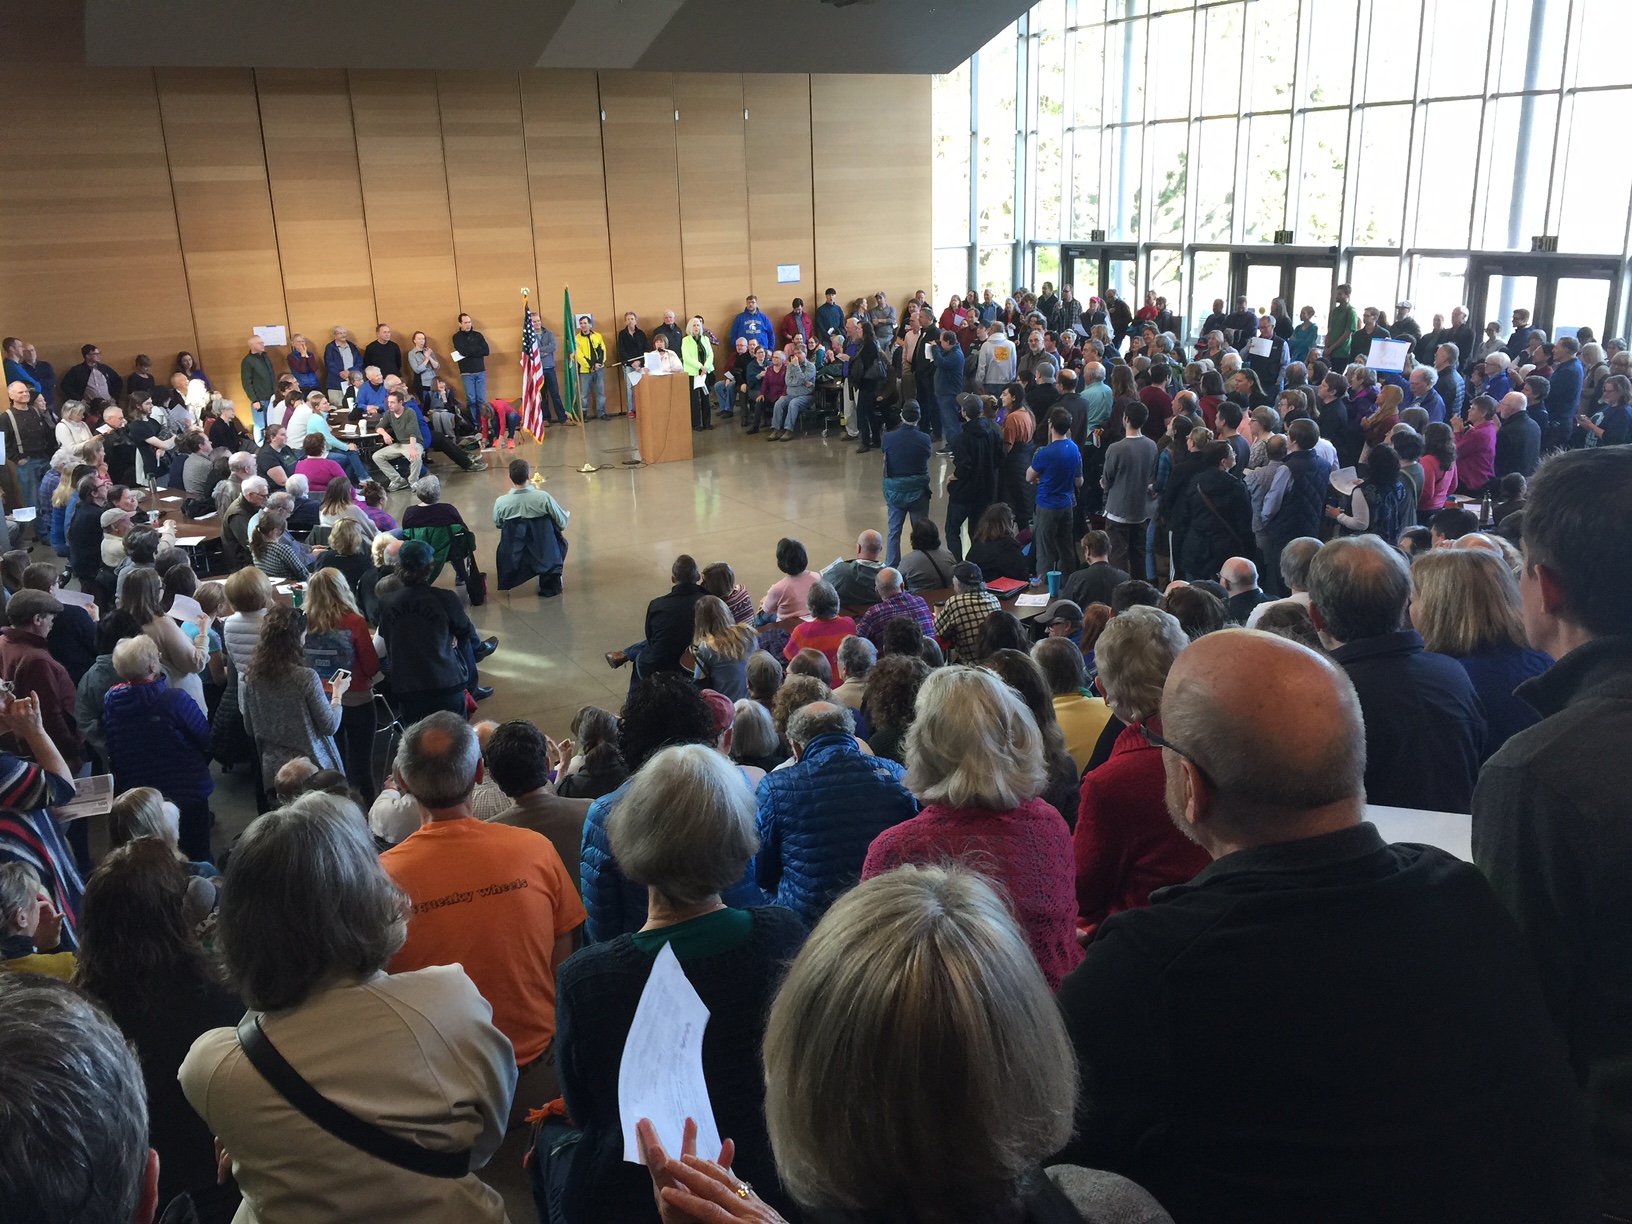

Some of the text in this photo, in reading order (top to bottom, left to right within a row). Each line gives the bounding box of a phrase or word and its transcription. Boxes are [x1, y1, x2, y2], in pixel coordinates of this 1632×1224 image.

[1536, 236, 1555, 252] EXIT
[411, 878, 529, 914] squeaky wheels
